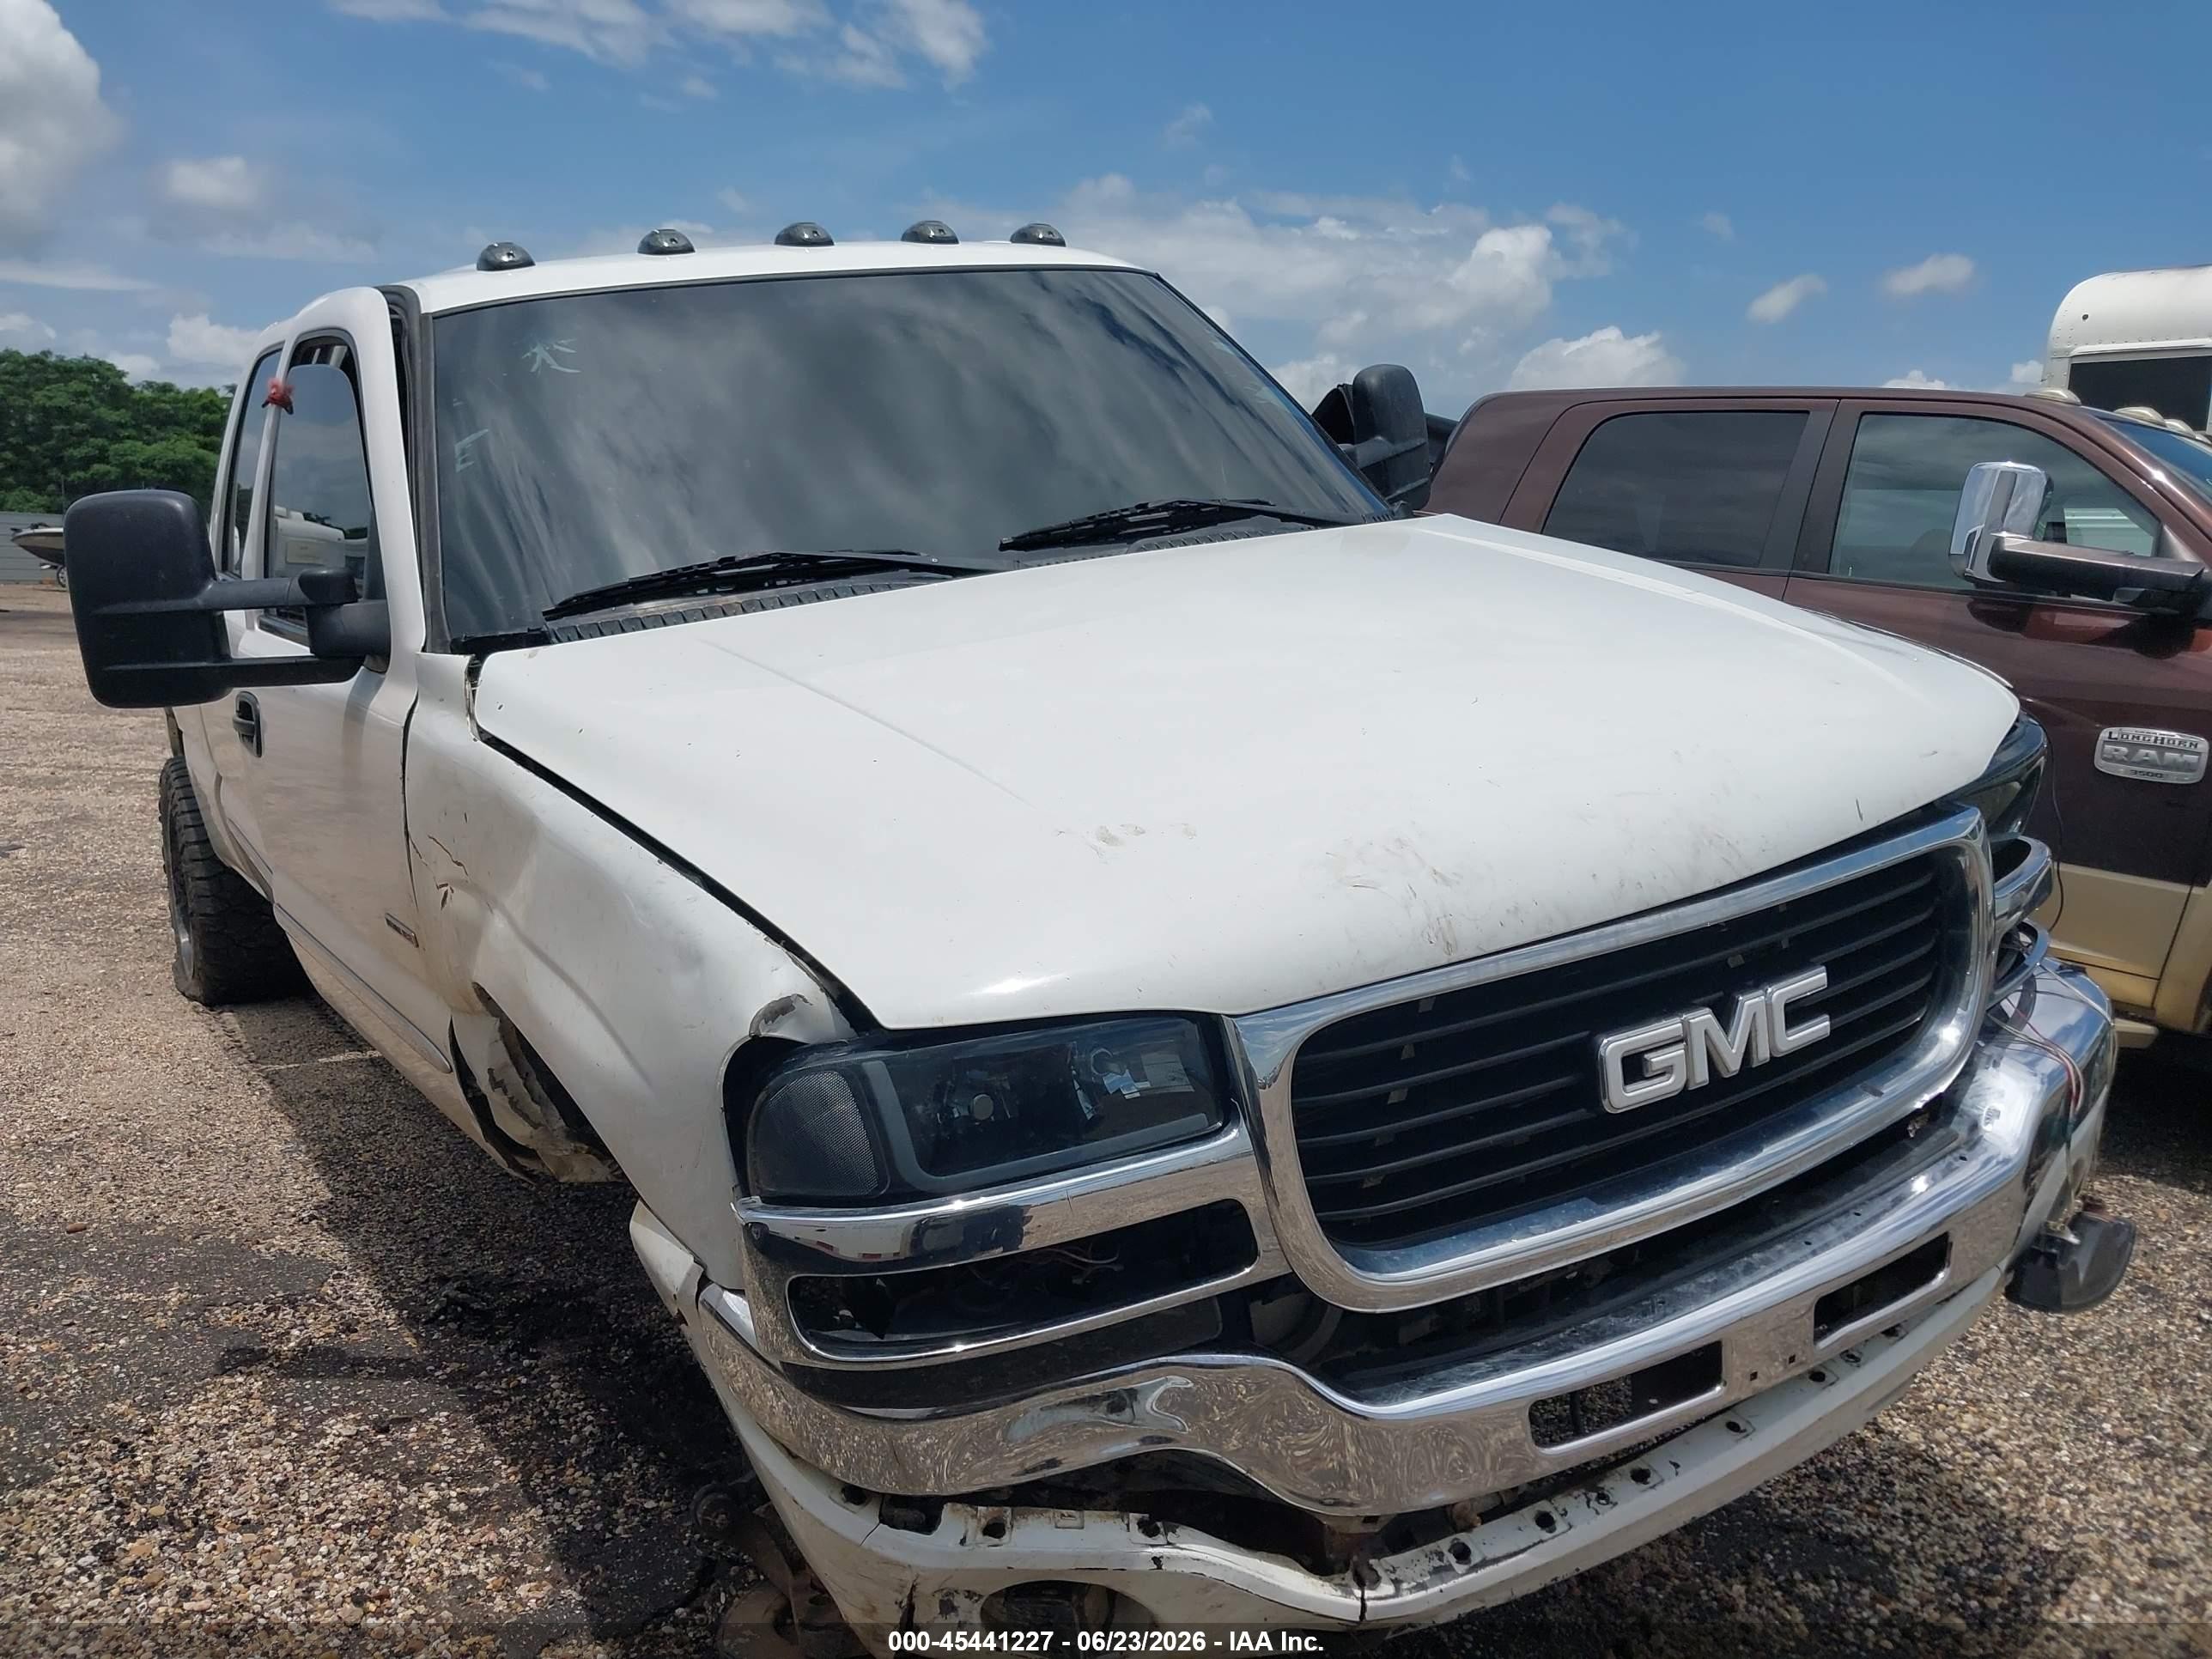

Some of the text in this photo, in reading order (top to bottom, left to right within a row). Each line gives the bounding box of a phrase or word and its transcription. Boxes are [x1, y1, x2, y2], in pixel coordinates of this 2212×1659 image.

[2103, 744, 2199, 772] RAM
[2130, 769, 2164, 779] 3500
[1599, 966, 1831, 1114] GMC
